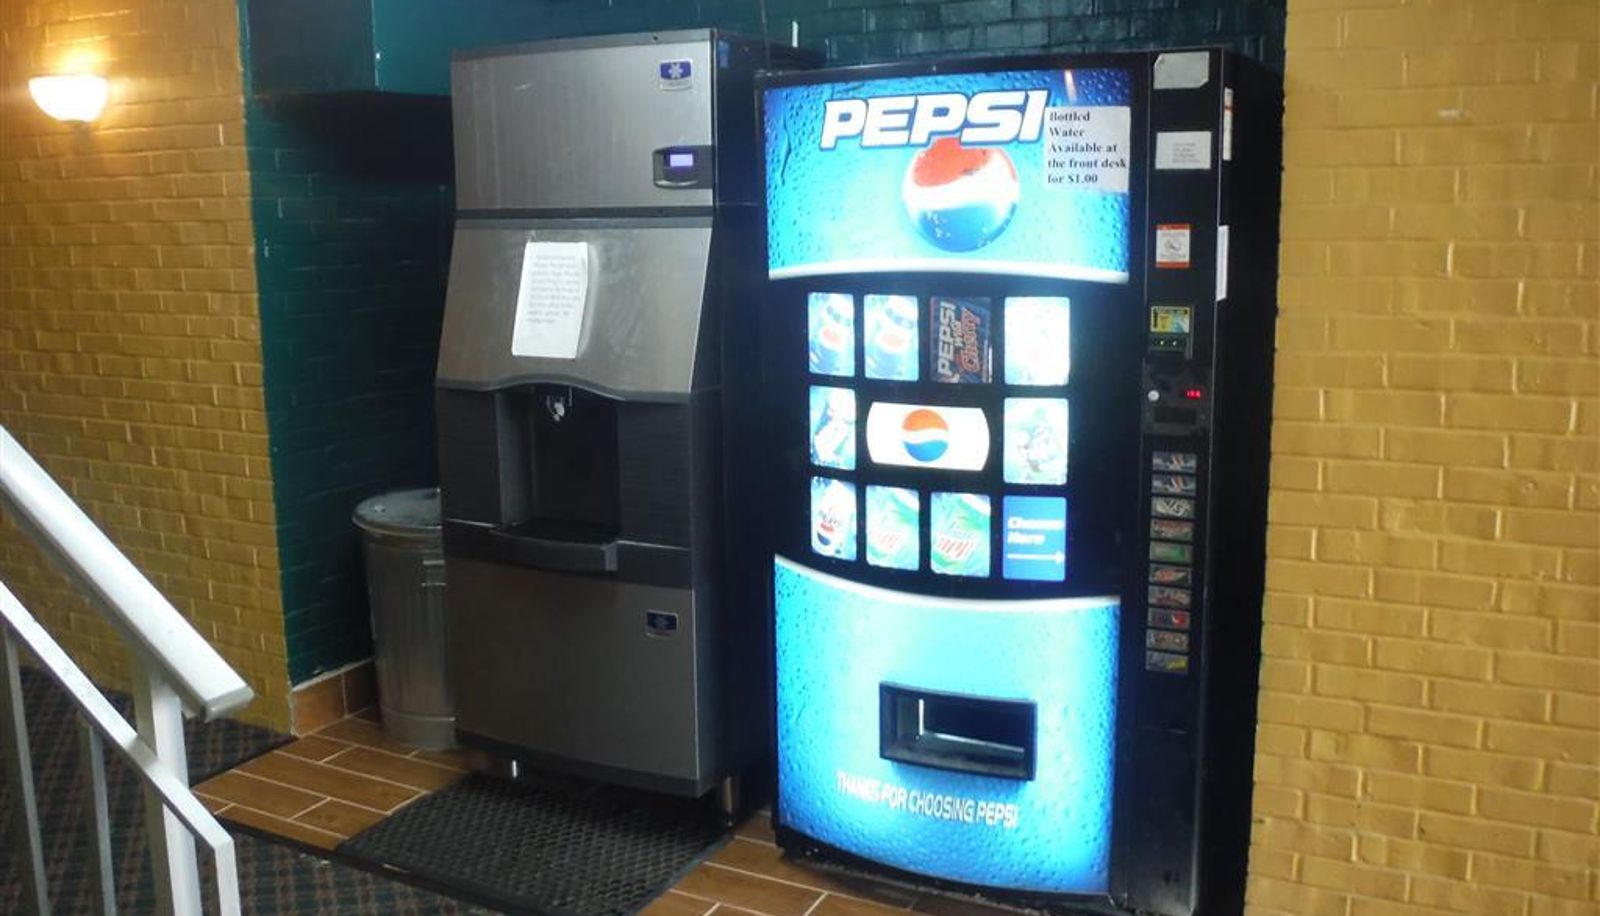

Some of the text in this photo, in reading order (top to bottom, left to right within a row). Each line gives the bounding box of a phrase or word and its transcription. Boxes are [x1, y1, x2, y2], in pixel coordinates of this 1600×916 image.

[819, 90, 1048, 150] PEPSI
[1049, 111, 1091, 121] Bottled
[1049, 127, 1085, 137] Water
[1050, 142, 1118, 153] Available at
[1047, 157, 1127, 168] the front desk
[1047, 173, 1098, 184] for $1.00
[937, 301, 957, 377] PEPSI
[881, 782, 907, 811] FOR
[908, 789, 974, 823] CHOOSING
[976, 800, 1020, 829] PEPSI
